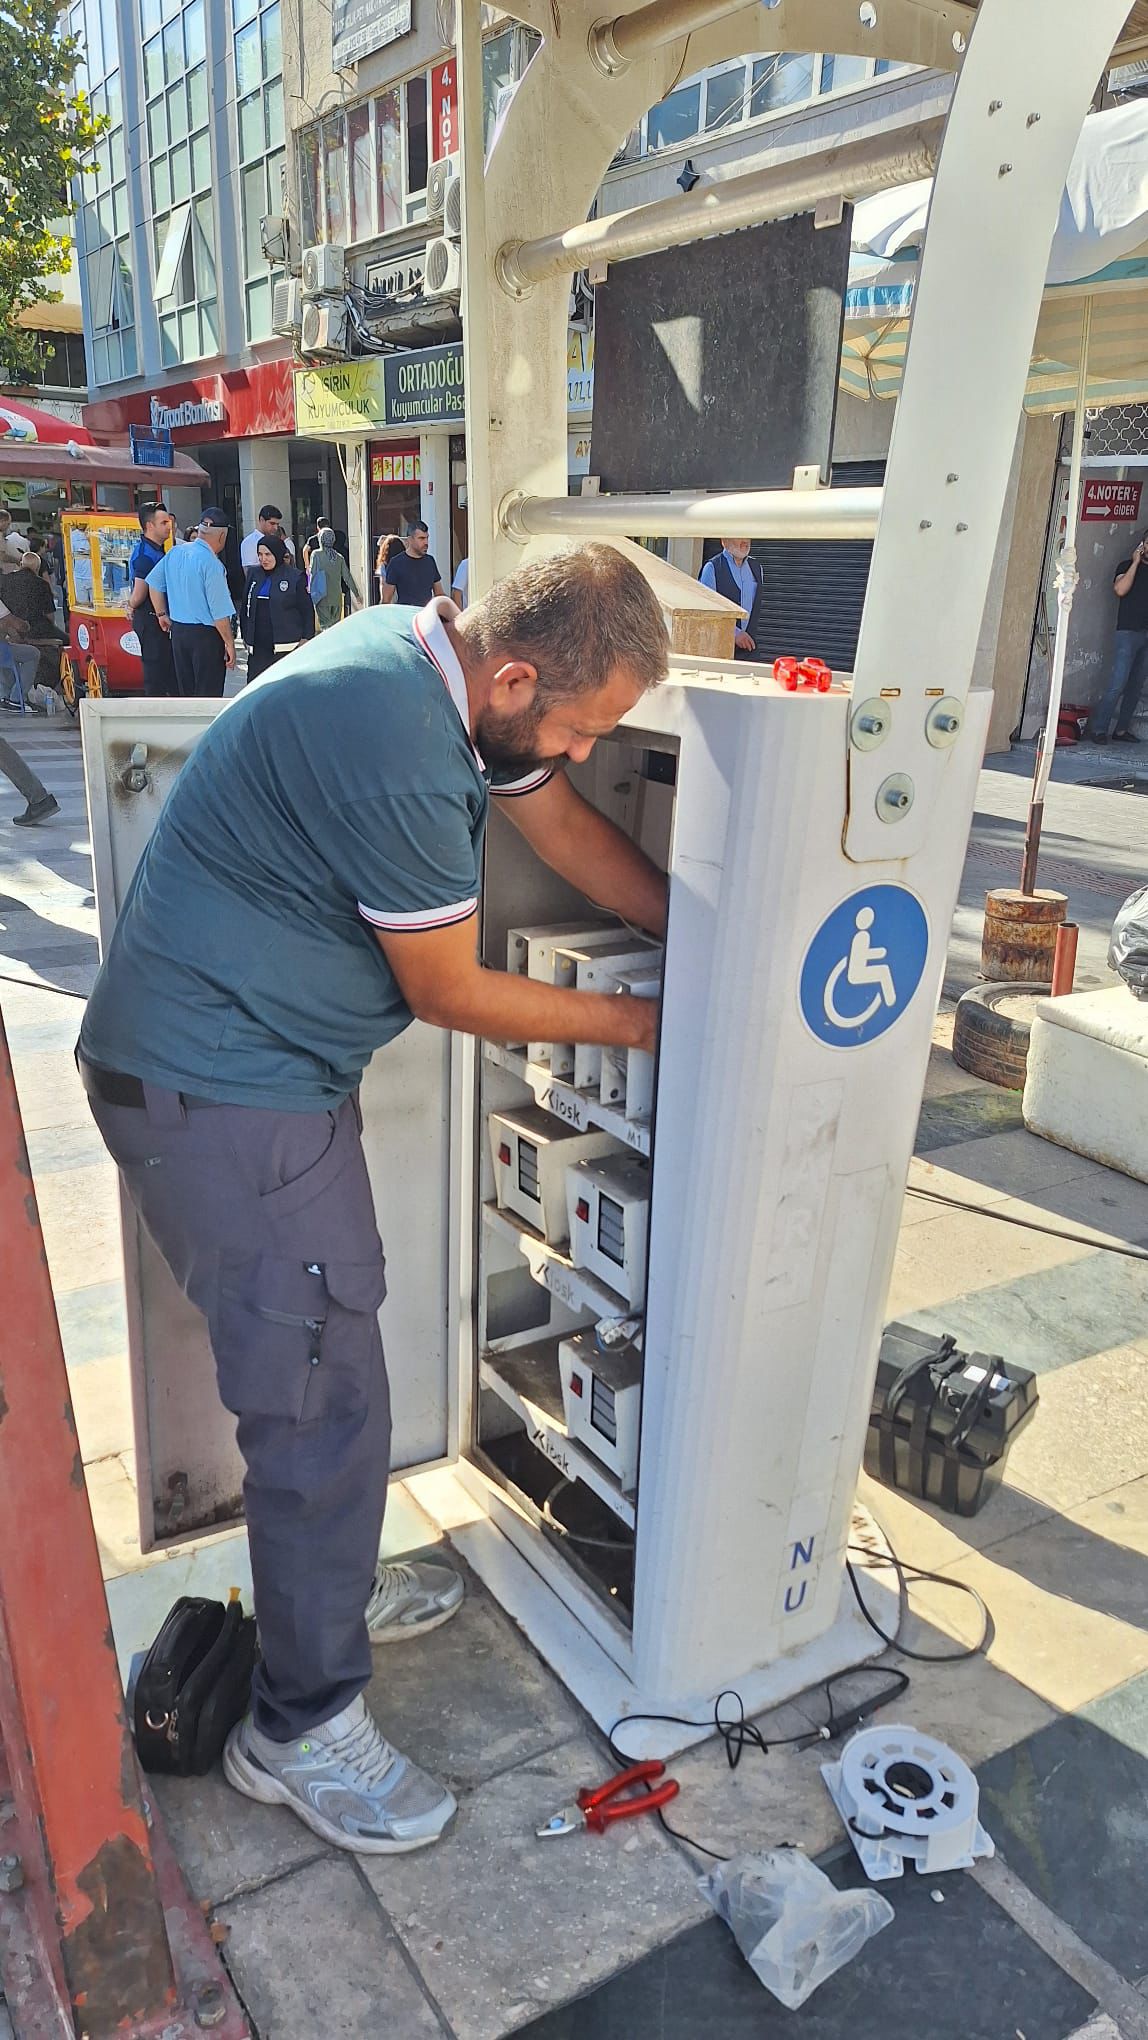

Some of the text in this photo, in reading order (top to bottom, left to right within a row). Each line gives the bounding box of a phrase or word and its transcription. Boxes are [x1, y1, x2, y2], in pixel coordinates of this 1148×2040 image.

[398, 351, 464, 394] ORTADOĞU
[158, 402, 185, 430] Ziraat
[308, 398, 370, 420] KUYUMCULUK
[391, 393, 443, 422] Kuyumcular
[1113, 502, 1136, 516] GİDER
[540, 1087, 581, 1126] Kiosk
[536, 1262, 575, 1305] Kiosk
